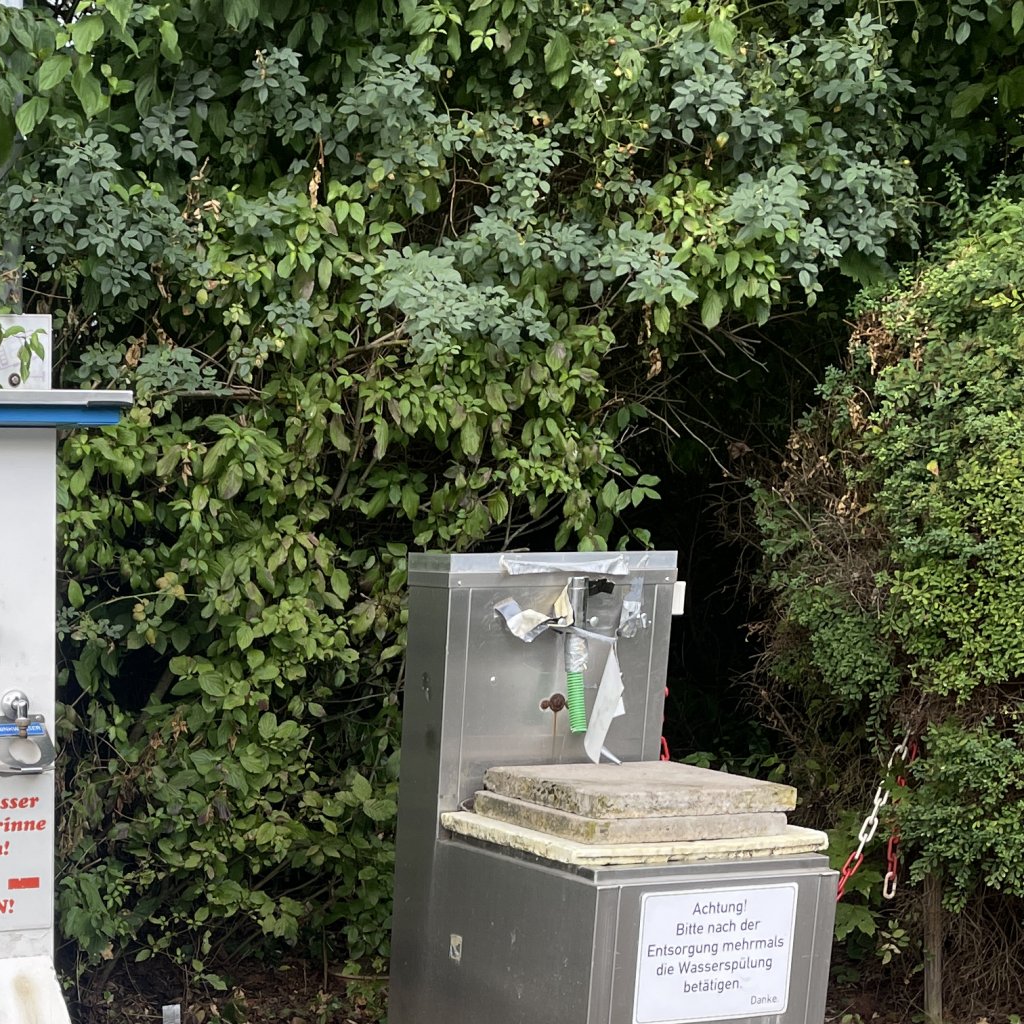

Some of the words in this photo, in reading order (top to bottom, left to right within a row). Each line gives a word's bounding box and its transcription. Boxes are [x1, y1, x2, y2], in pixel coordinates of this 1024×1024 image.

[692, 899, 747, 916] Achtung!
[676, 922, 704, 937] Bitte
[707, 919, 736, 934] nach
[740, 918, 761, 932] der
[647, 943, 718, 958] Entsorgung
[722, 936, 785, 952] mehrmals
[656, 963, 675, 977] die
[678, 957, 773, 975] Wasserspülung
[683, 978, 743, 995] betätigen.
